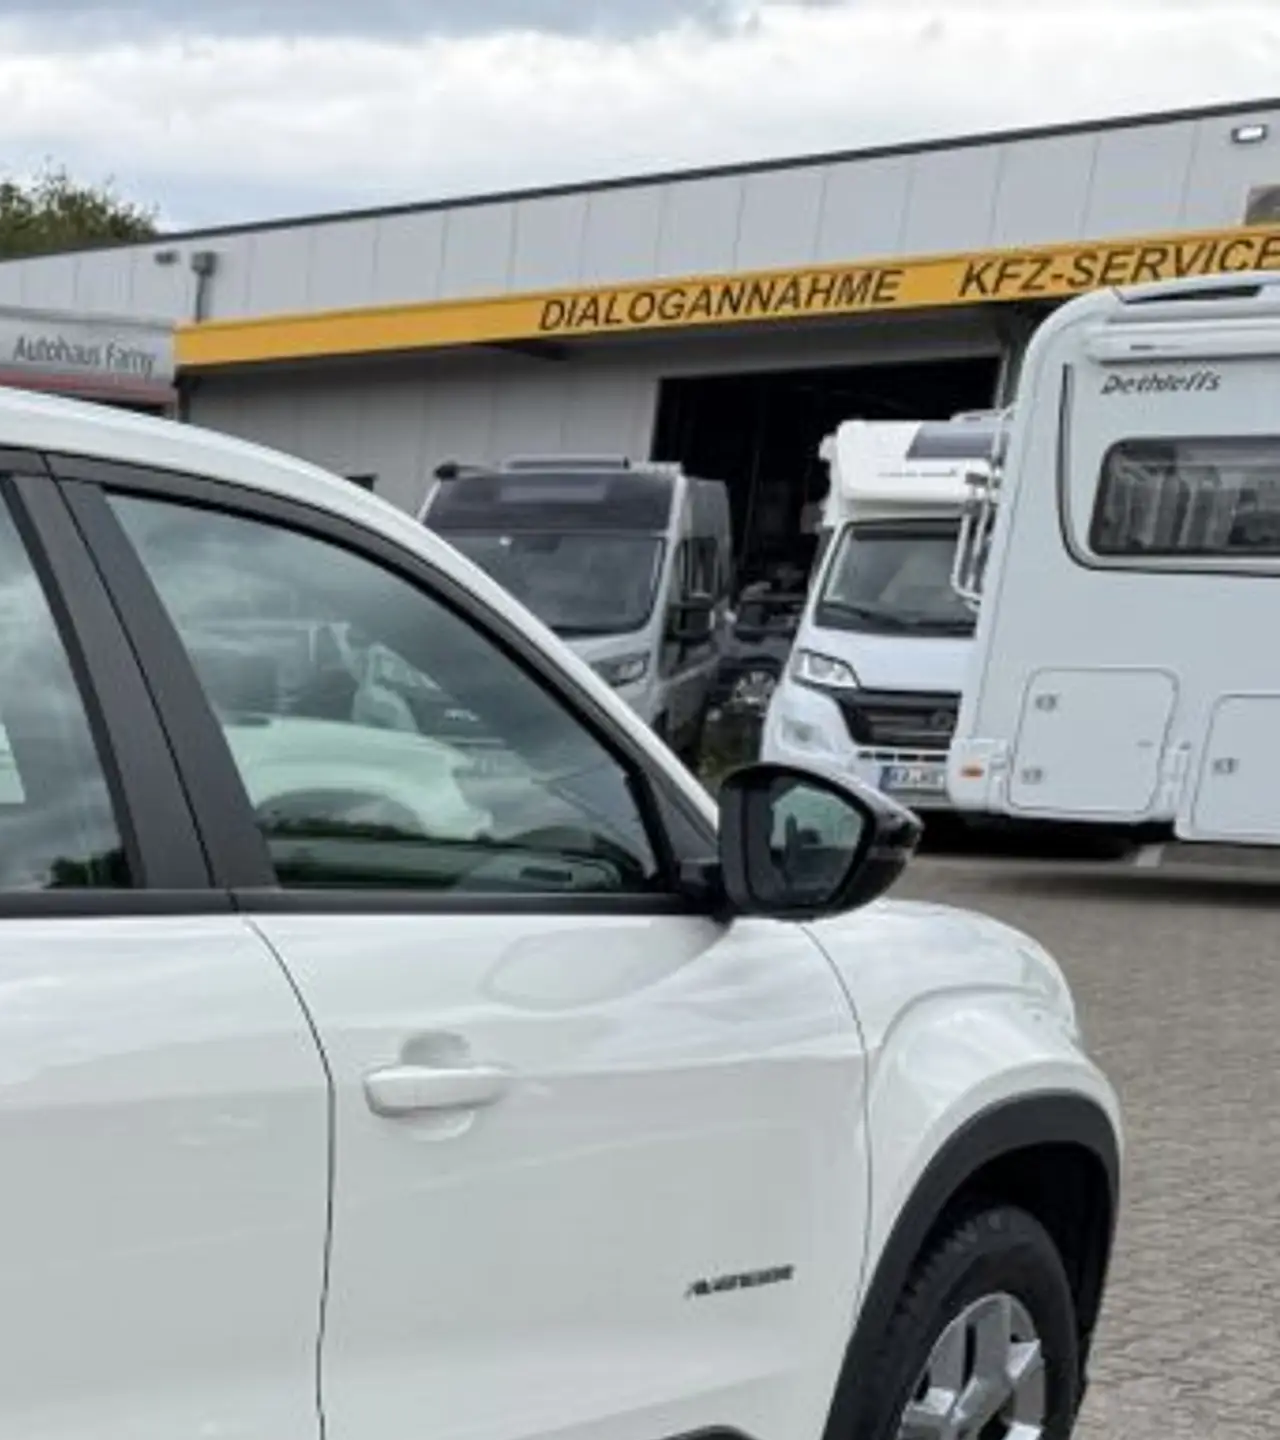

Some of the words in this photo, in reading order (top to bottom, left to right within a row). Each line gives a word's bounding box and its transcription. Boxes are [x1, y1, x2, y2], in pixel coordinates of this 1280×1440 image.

[958, 234, 1280, 298] KFZ-SERVICE
[538, 269, 905, 331] DIALOGANNAHME
[13, 334, 101, 368] Autohaus
